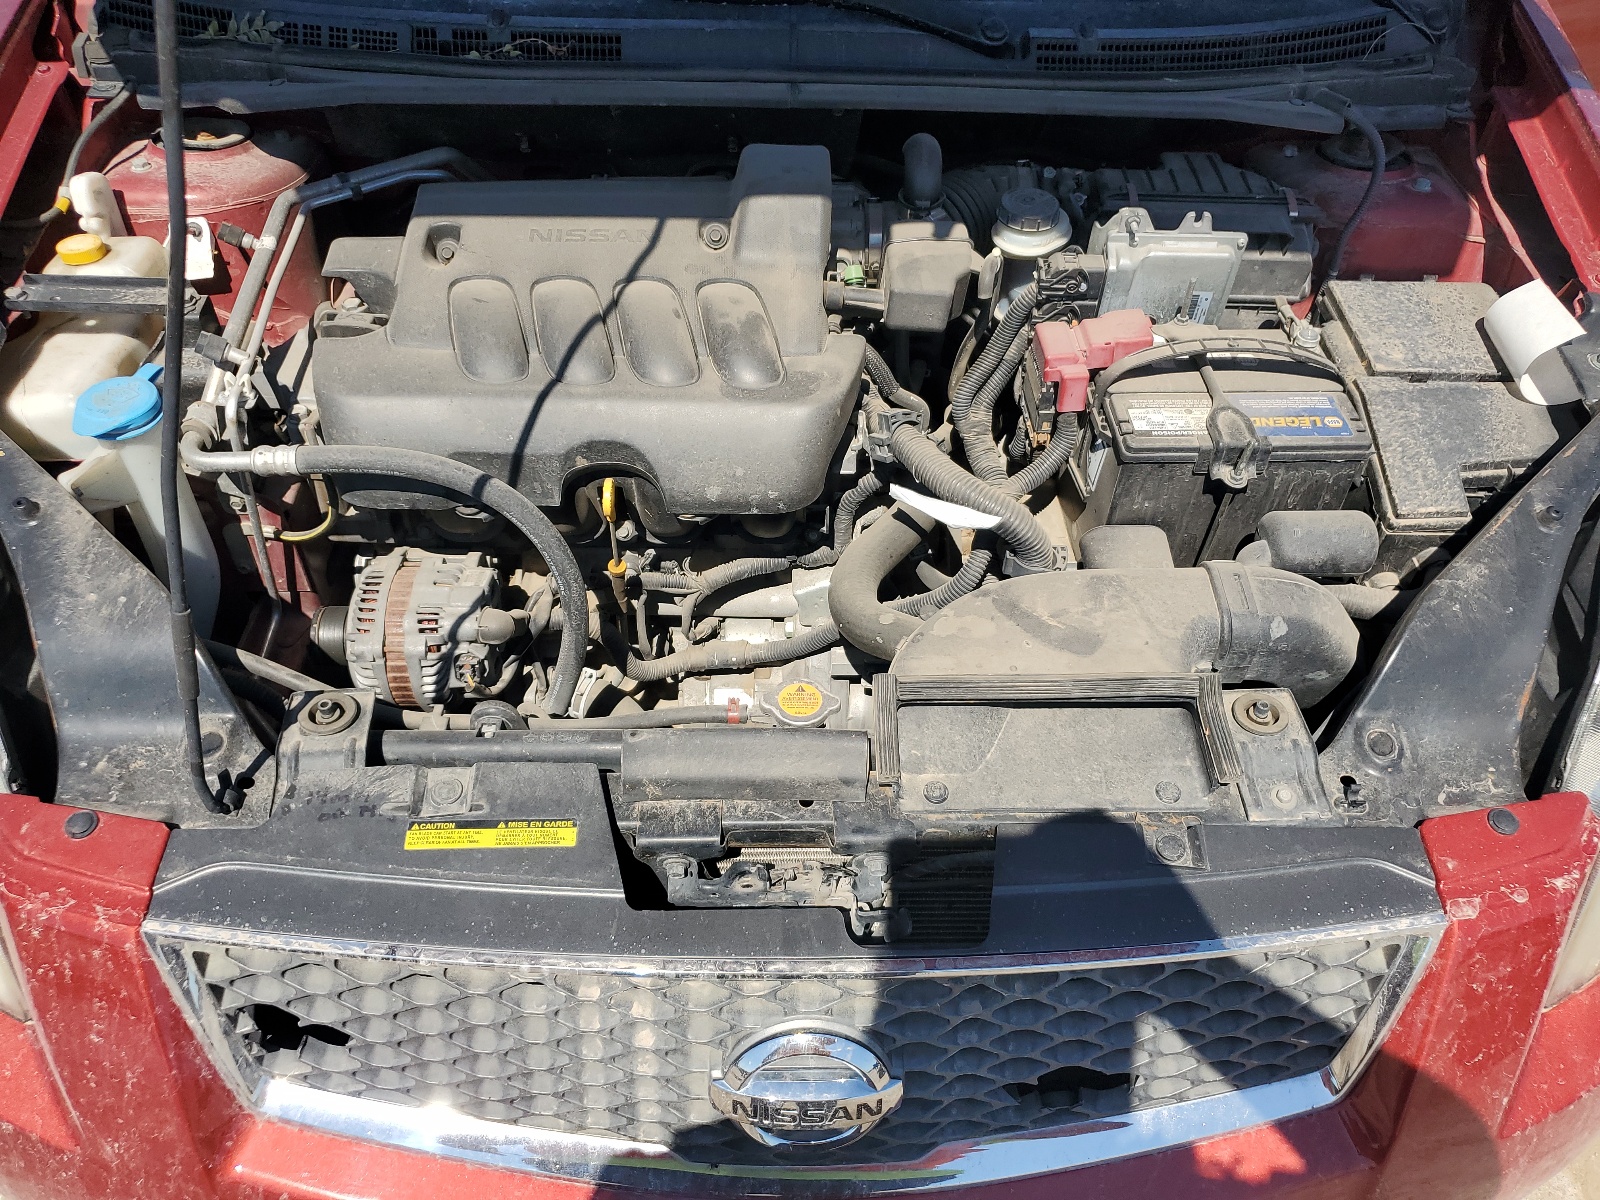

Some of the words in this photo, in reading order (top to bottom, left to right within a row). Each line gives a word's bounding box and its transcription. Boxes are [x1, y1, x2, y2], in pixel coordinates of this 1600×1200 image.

[528, 228, 654, 243] NISSAN
[1249, 415, 1323, 428] LEGEND
[420, 822, 456, 830] CAUTION
[543, 820, 574, 828] GARDE
[731, 1098, 884, 1126] NISSAN
